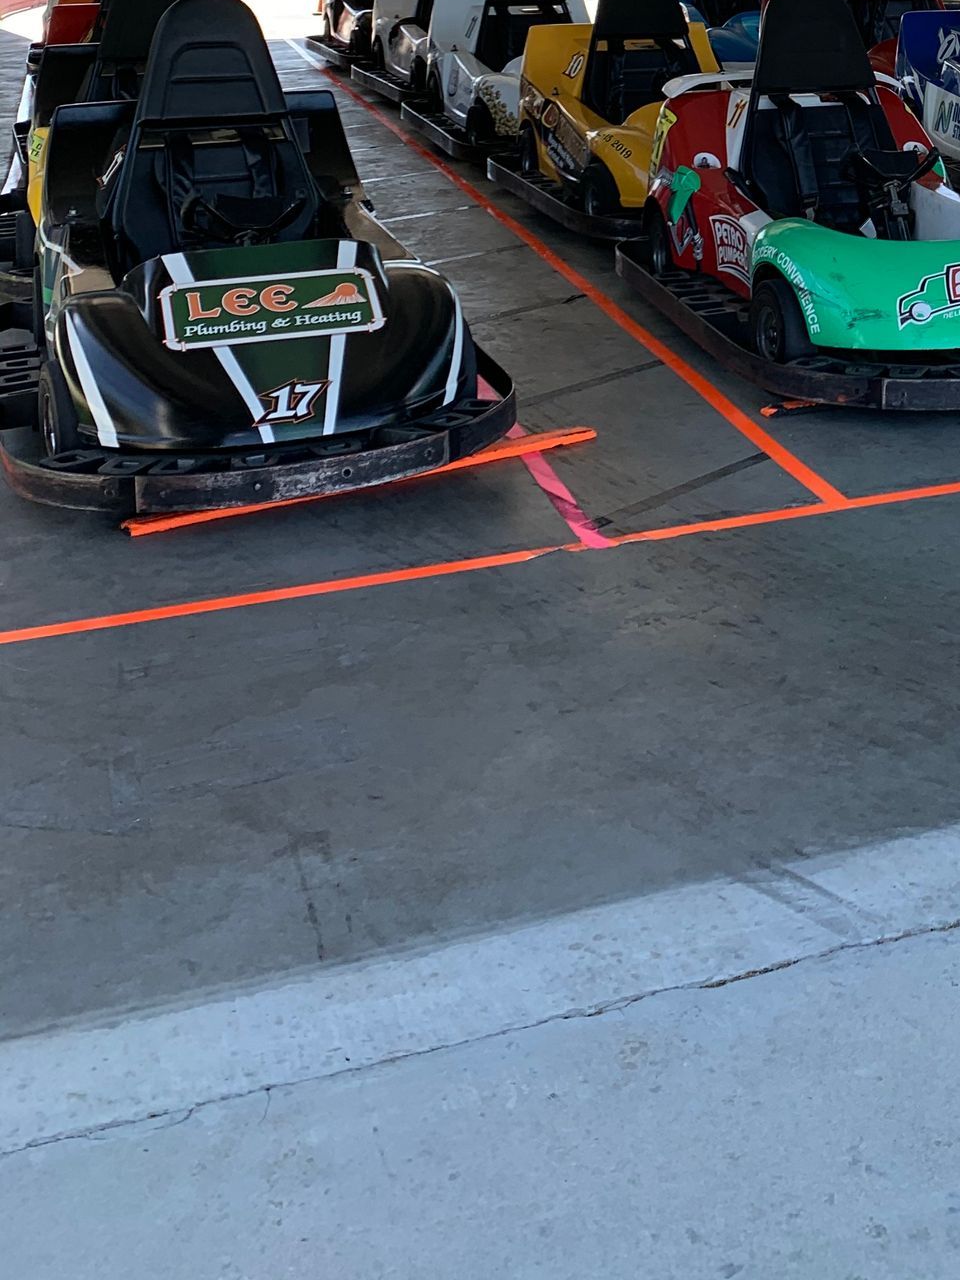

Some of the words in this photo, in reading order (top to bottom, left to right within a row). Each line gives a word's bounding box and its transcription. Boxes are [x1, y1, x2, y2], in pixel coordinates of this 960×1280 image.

[563, 52, 585, 78] 10
[610, 139, 633, 159] 2019
[714, 221, 744, 251] PETRO
[185, 284, 299, 320] LEE
[776, 252, 821, 335] CONVENIENCE
[184, 319, 268, 338] Plumbing
[271, 317, 292, 328] &
[294, 310, 363, 327] Heating
[264, 383, 323, 420] 17
